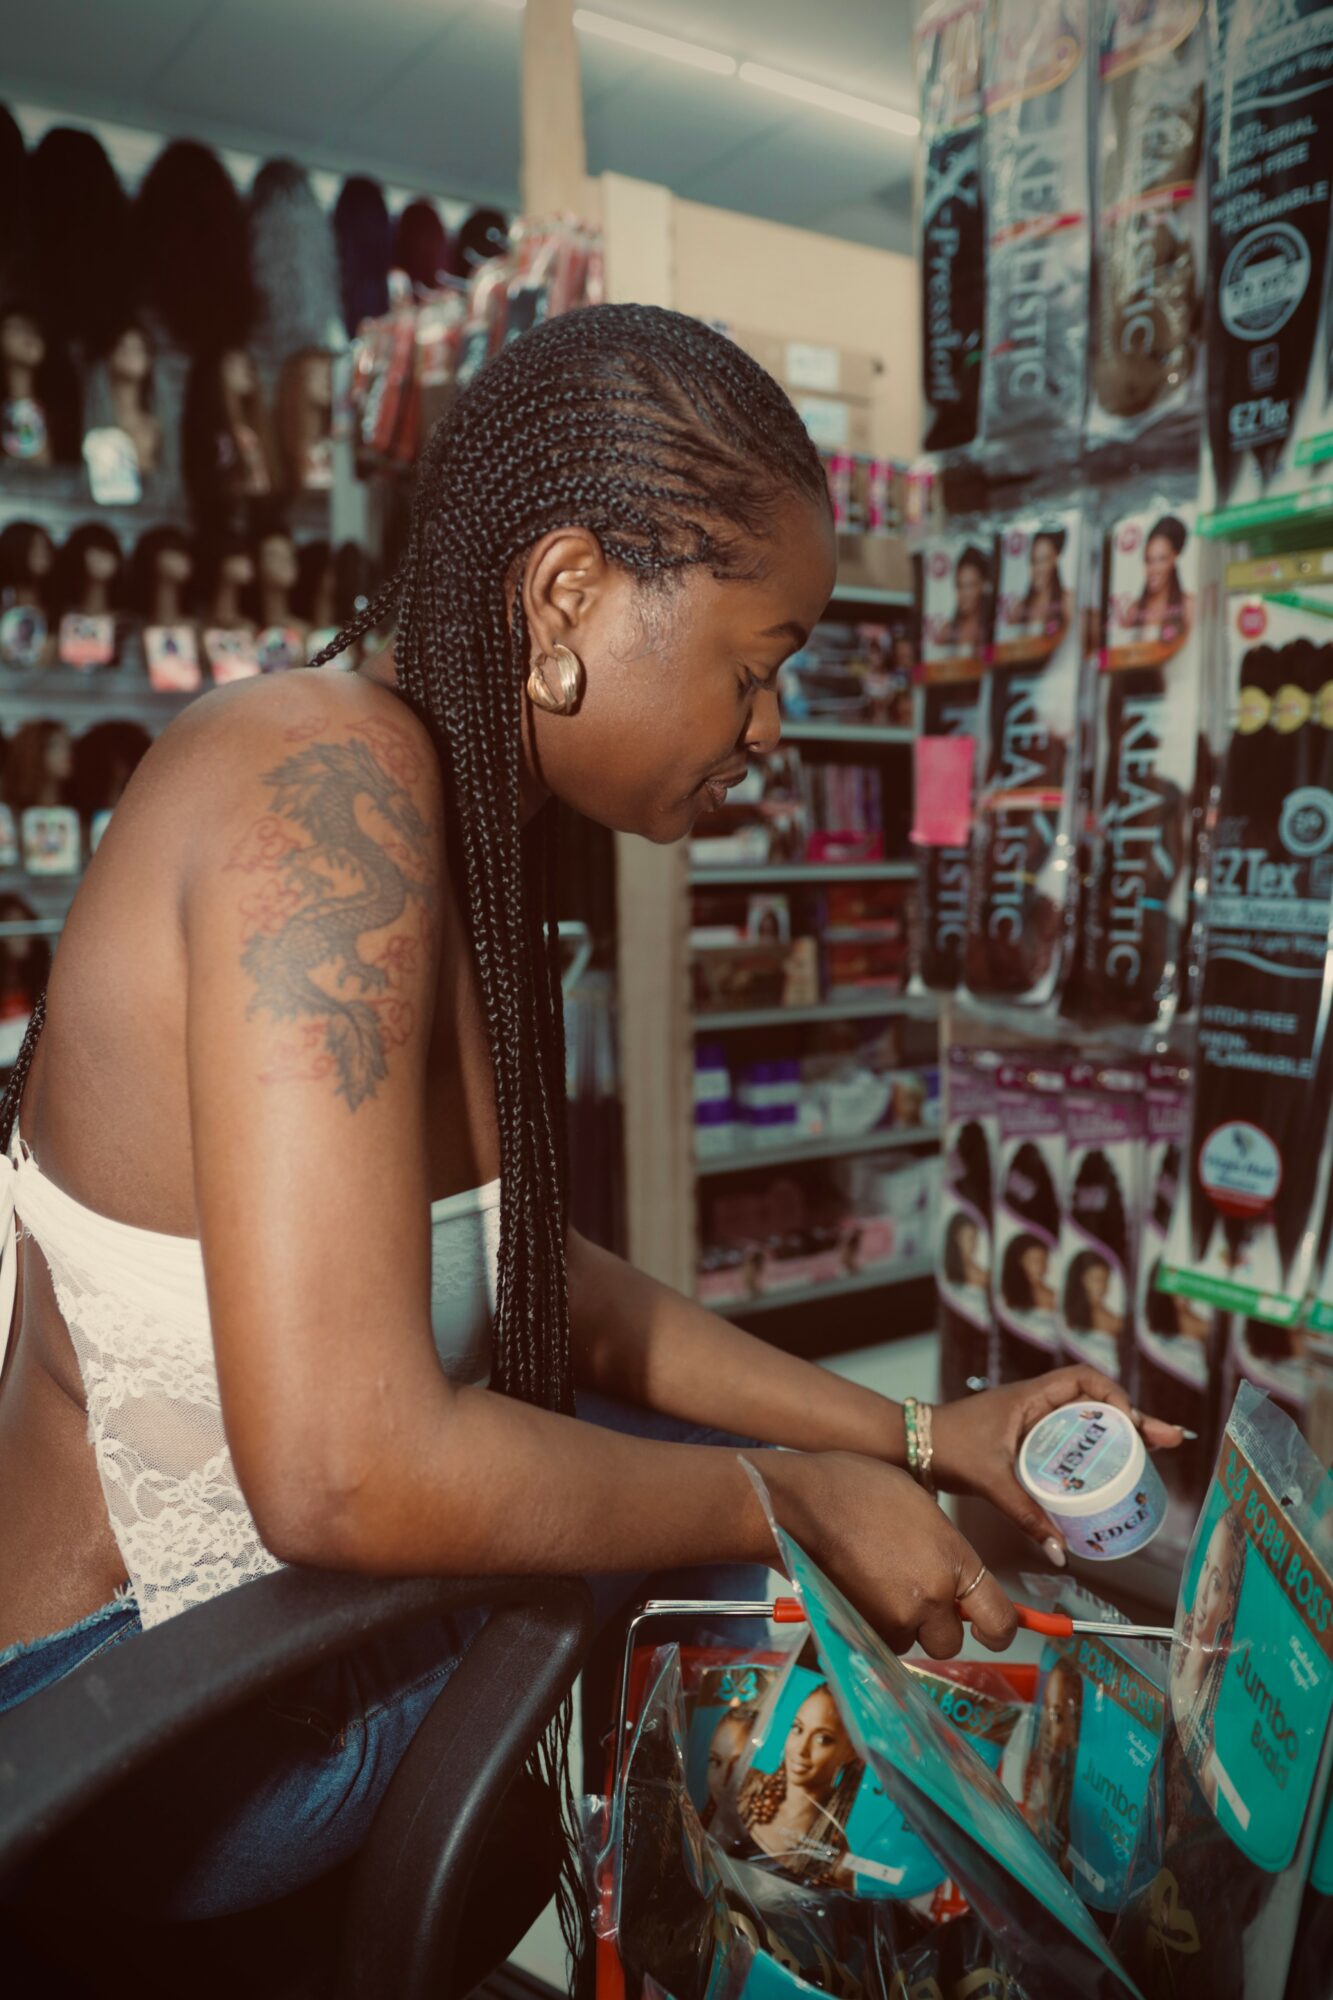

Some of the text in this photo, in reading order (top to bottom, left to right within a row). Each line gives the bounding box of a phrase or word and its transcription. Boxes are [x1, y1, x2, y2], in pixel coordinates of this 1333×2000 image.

[1263, 141, 1310, 176] FREE
[1223, 180, 1328, 235] FLAMMABLE
[1252, 1009, 1298, 1034] FREE
[1205, 1049, 1313, 1080] FLAMMABLE
[1053, 1423, 1108, 1476] EDGE
[1093, 1508, 1150, 1542] EDGE
[1244, 1490, 1290, 1568] BOBBI
[1286, 1554, 1331, 1632] BOSS
[1078, 1639, 1155, 1721] BOBBI BOSS
[1235, 1648, 1298, 1761] Jumbo
[940, 1690, 995, 1732] BOSS
[1082, 1757, 1139, 1827] Jumbo
